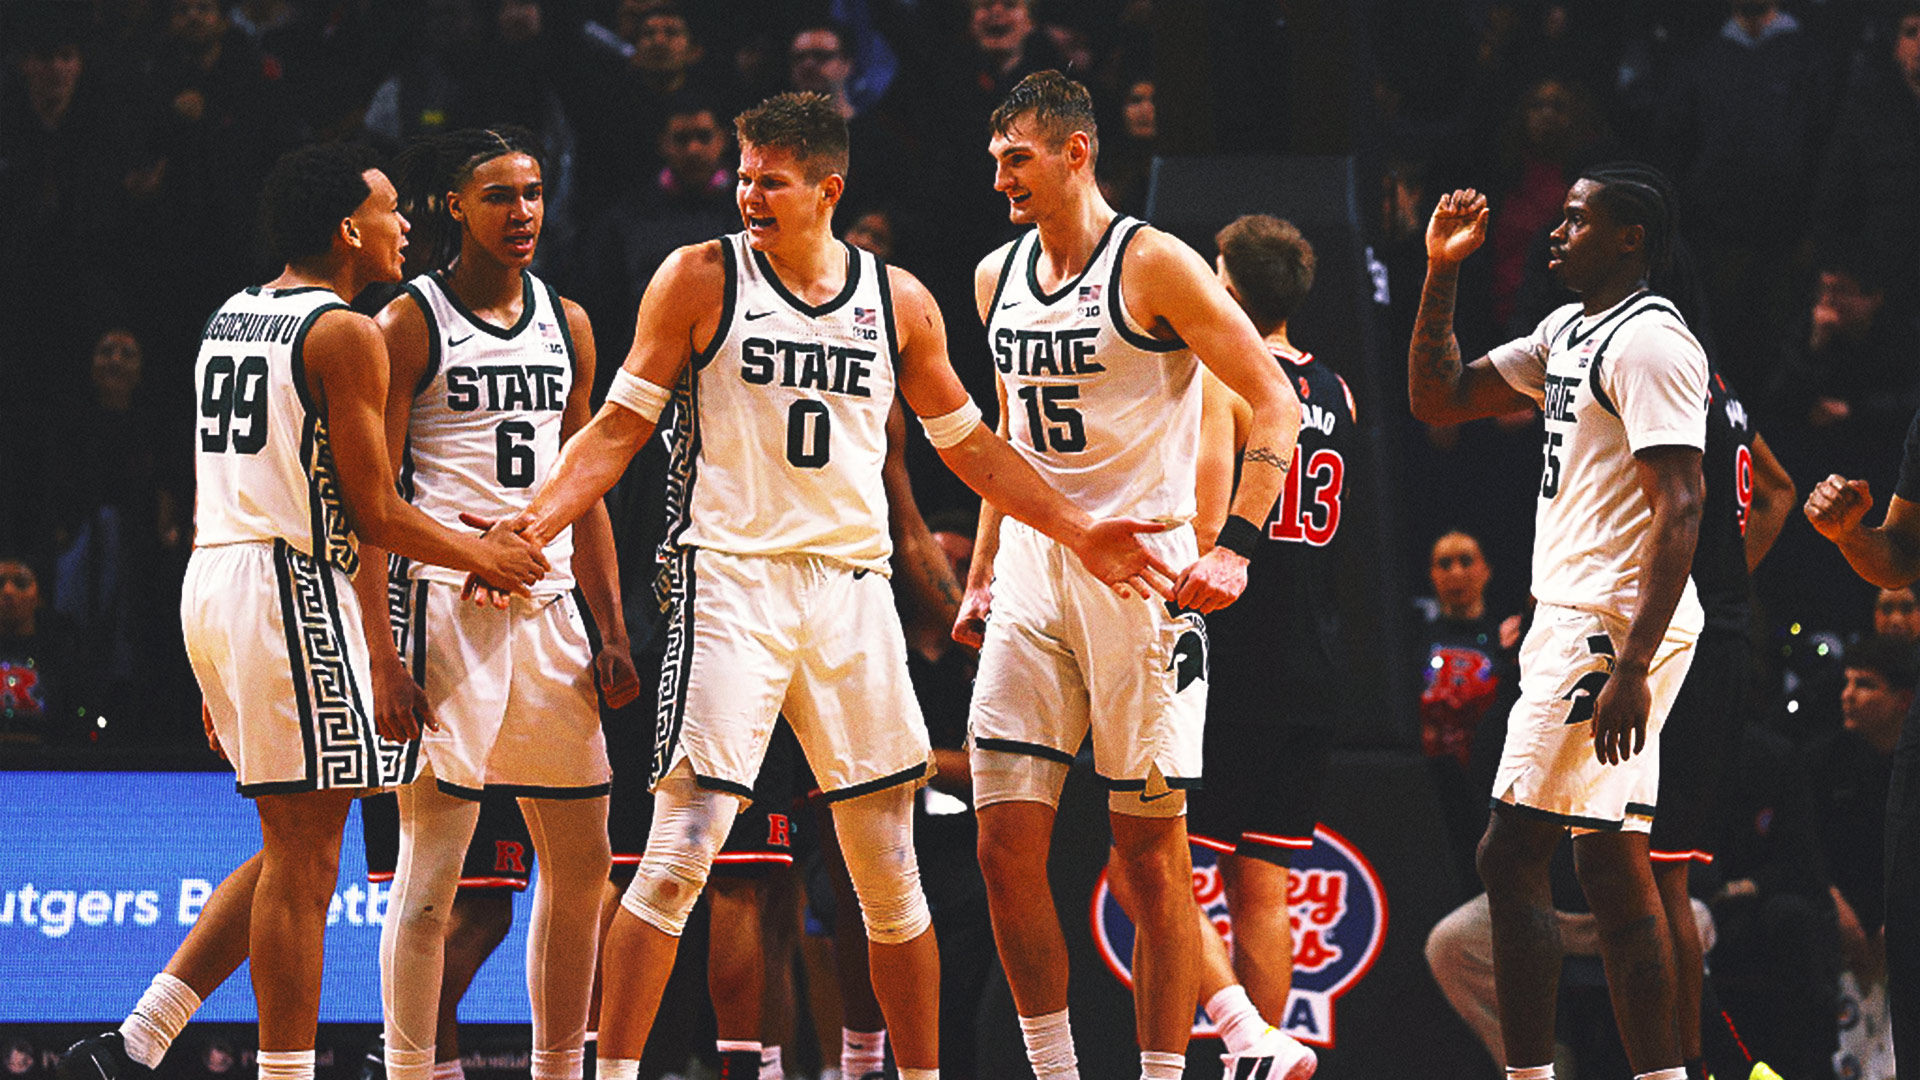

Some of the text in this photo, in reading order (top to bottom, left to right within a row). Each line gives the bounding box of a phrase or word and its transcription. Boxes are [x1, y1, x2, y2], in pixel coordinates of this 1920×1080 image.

[741, 337, 877, 398] STATE
[995, 327, 1106, 376] STATE
[200, 355, 269, 455] 99
[446, 365, 565, 412] STATE
[1017, 385, 1087, 453] 15
[495, 421, 535, 488] 6
[787, 399, 831, 468] 0
[1542, 431, 1563, 499] 5
[1268, 443, 1345, 547] 13
[495, 840, 526, 873] R
[767, 813, 791, 848] R
